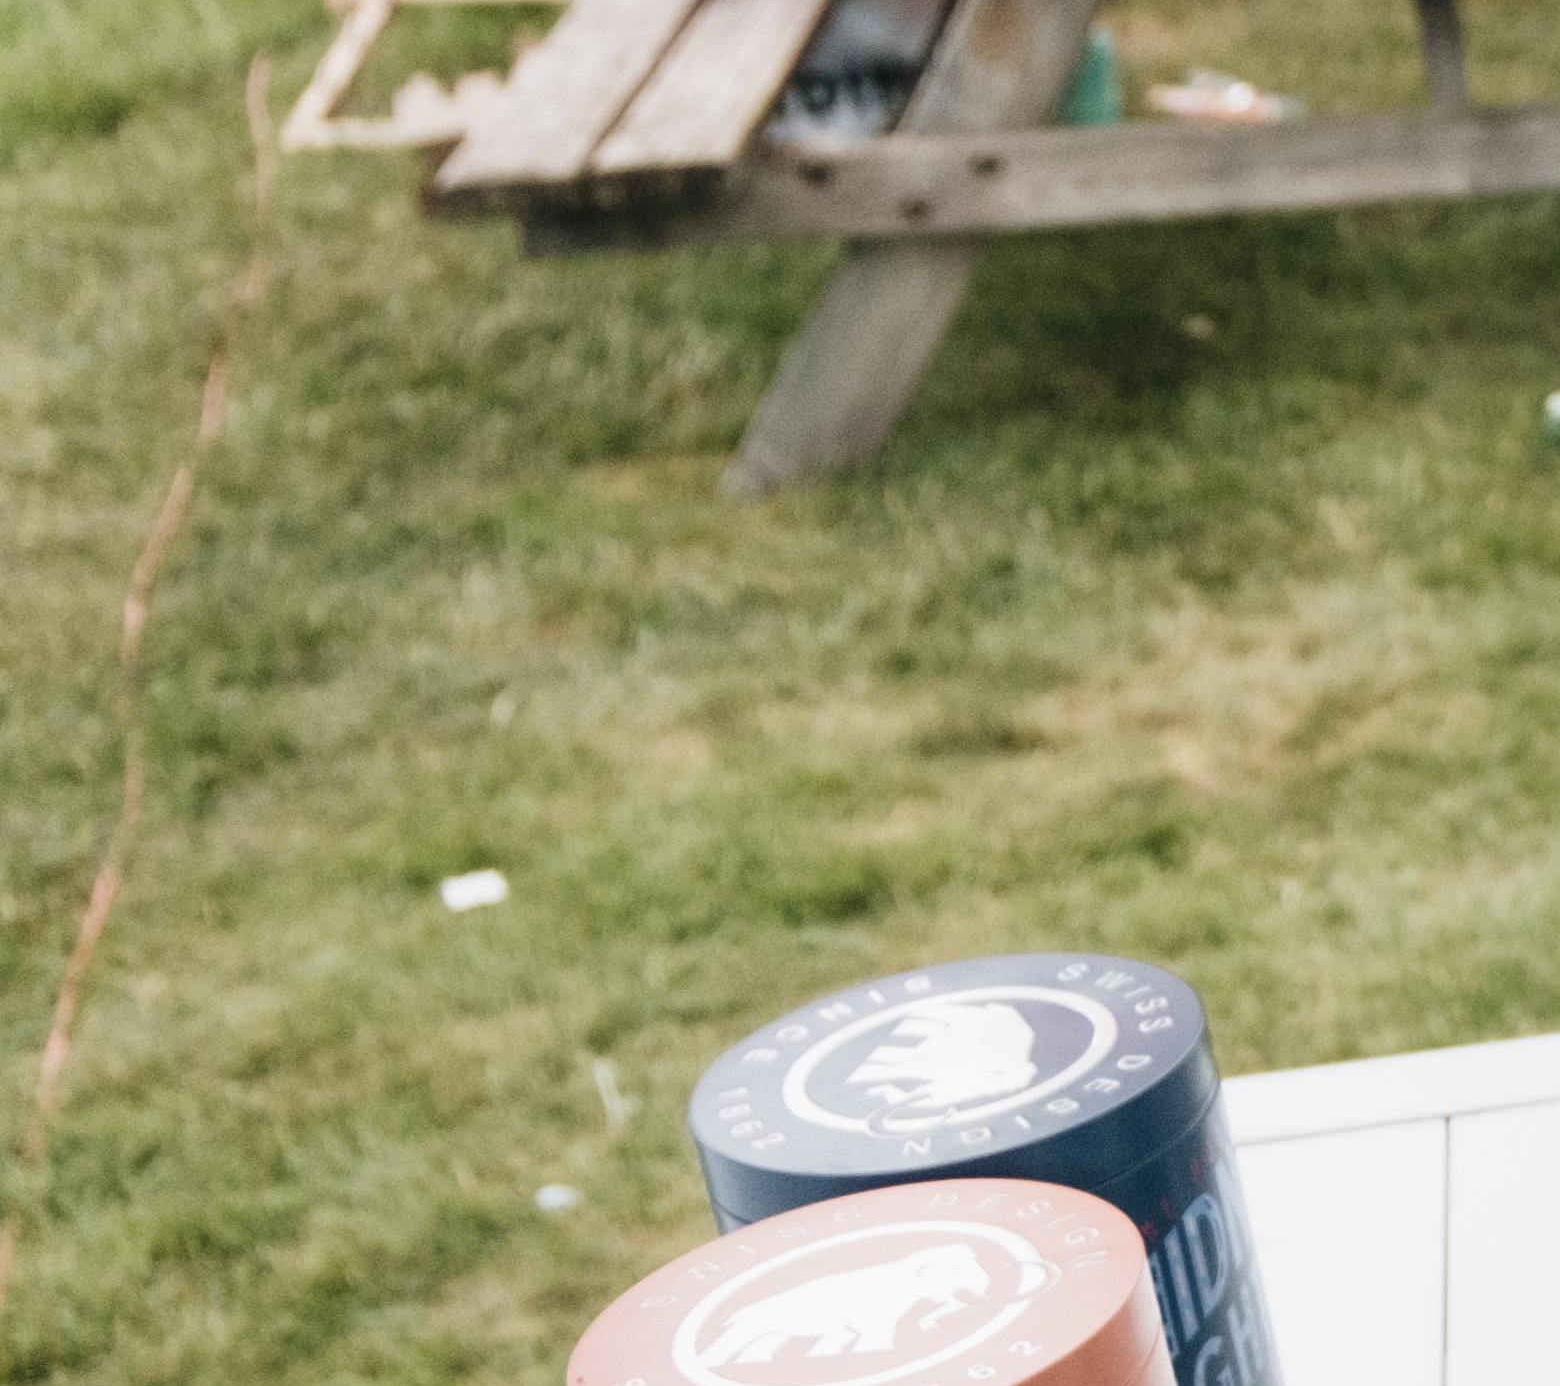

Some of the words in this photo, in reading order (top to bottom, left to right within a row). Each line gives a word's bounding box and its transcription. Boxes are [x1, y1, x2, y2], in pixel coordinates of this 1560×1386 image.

[1057, 961, 1174, 1036] SWISS
[717, 1085, 788, 1153] 1862
[901, 1053, 1153, 1159] DESIGN
[639, 1204, 861, 1311] SWISS
[928, 1191, 1109, 1273] DESIGN
